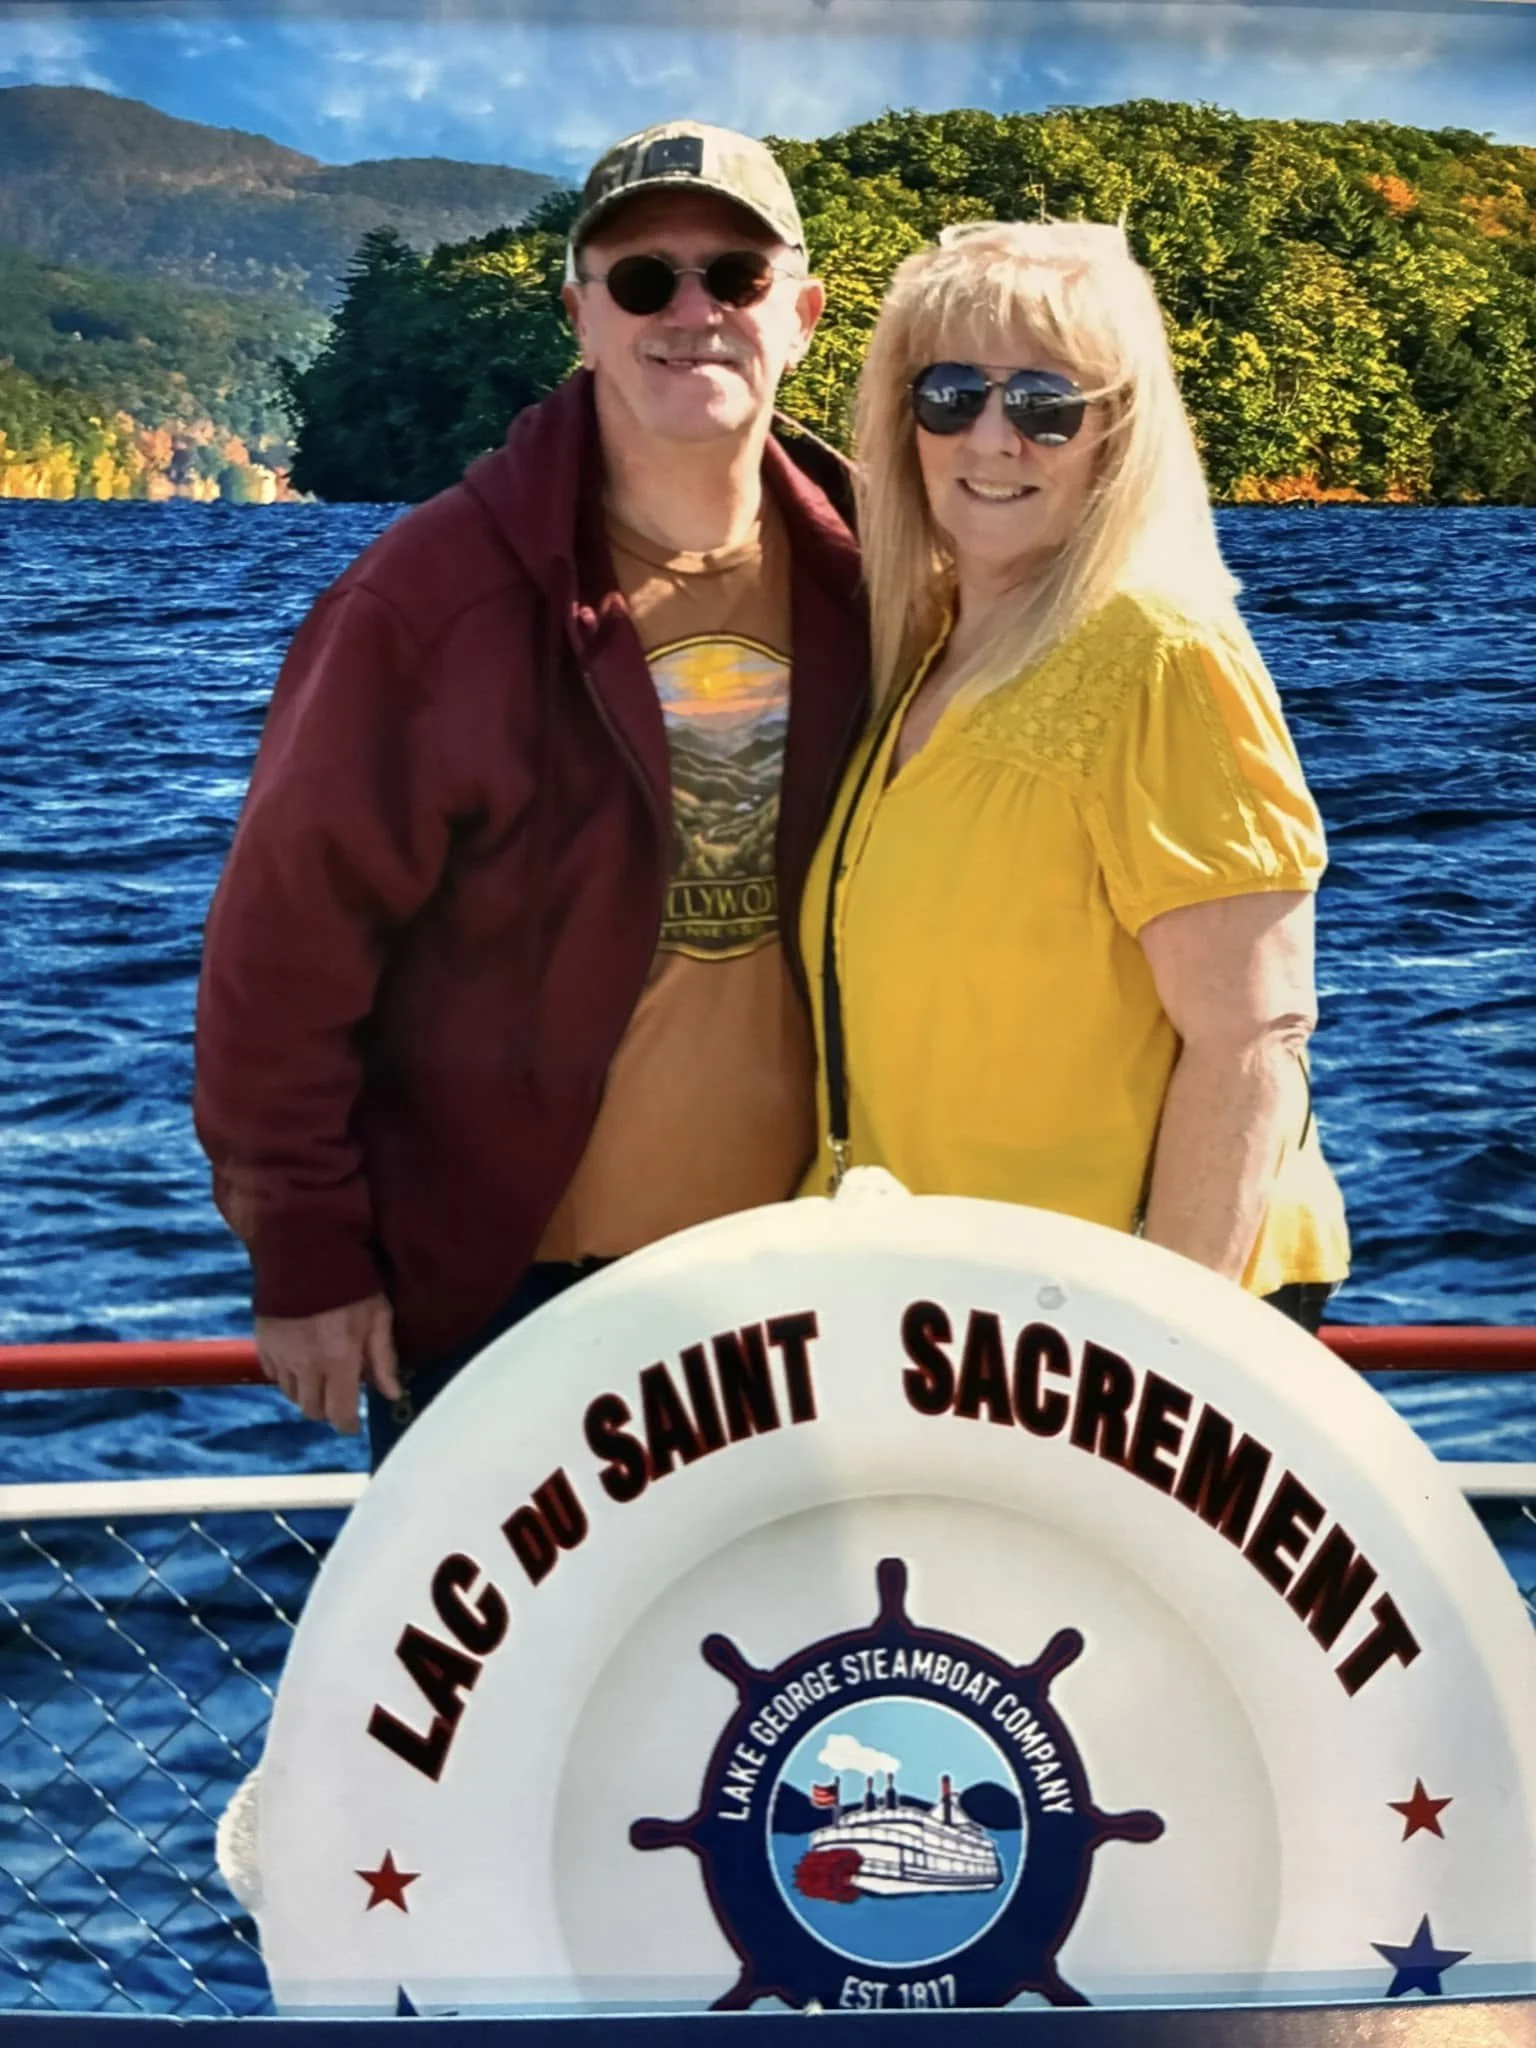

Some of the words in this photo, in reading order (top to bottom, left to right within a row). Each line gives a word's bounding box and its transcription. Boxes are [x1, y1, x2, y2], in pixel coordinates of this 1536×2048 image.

[668, 883, 777, 918] LLYWO
[366, 1553, 509, 1783] LAC
[501, 1467, 589, 1587] DU
[584, 1310, 819, 1503] SAINT
[901, 1300, 1422, 1697] SACREMENT
[718, 1742, 767, 1821] LAKE
[749, 1662, 842, 1747] GEORGE
[841, 1648, 1002, 1706] STEAMBOAT
[991, 1693, 1074, 1814] COMPANY
[839, 1975, 889, 2009] EST
[898, 1973, 956, 2009] 1817
